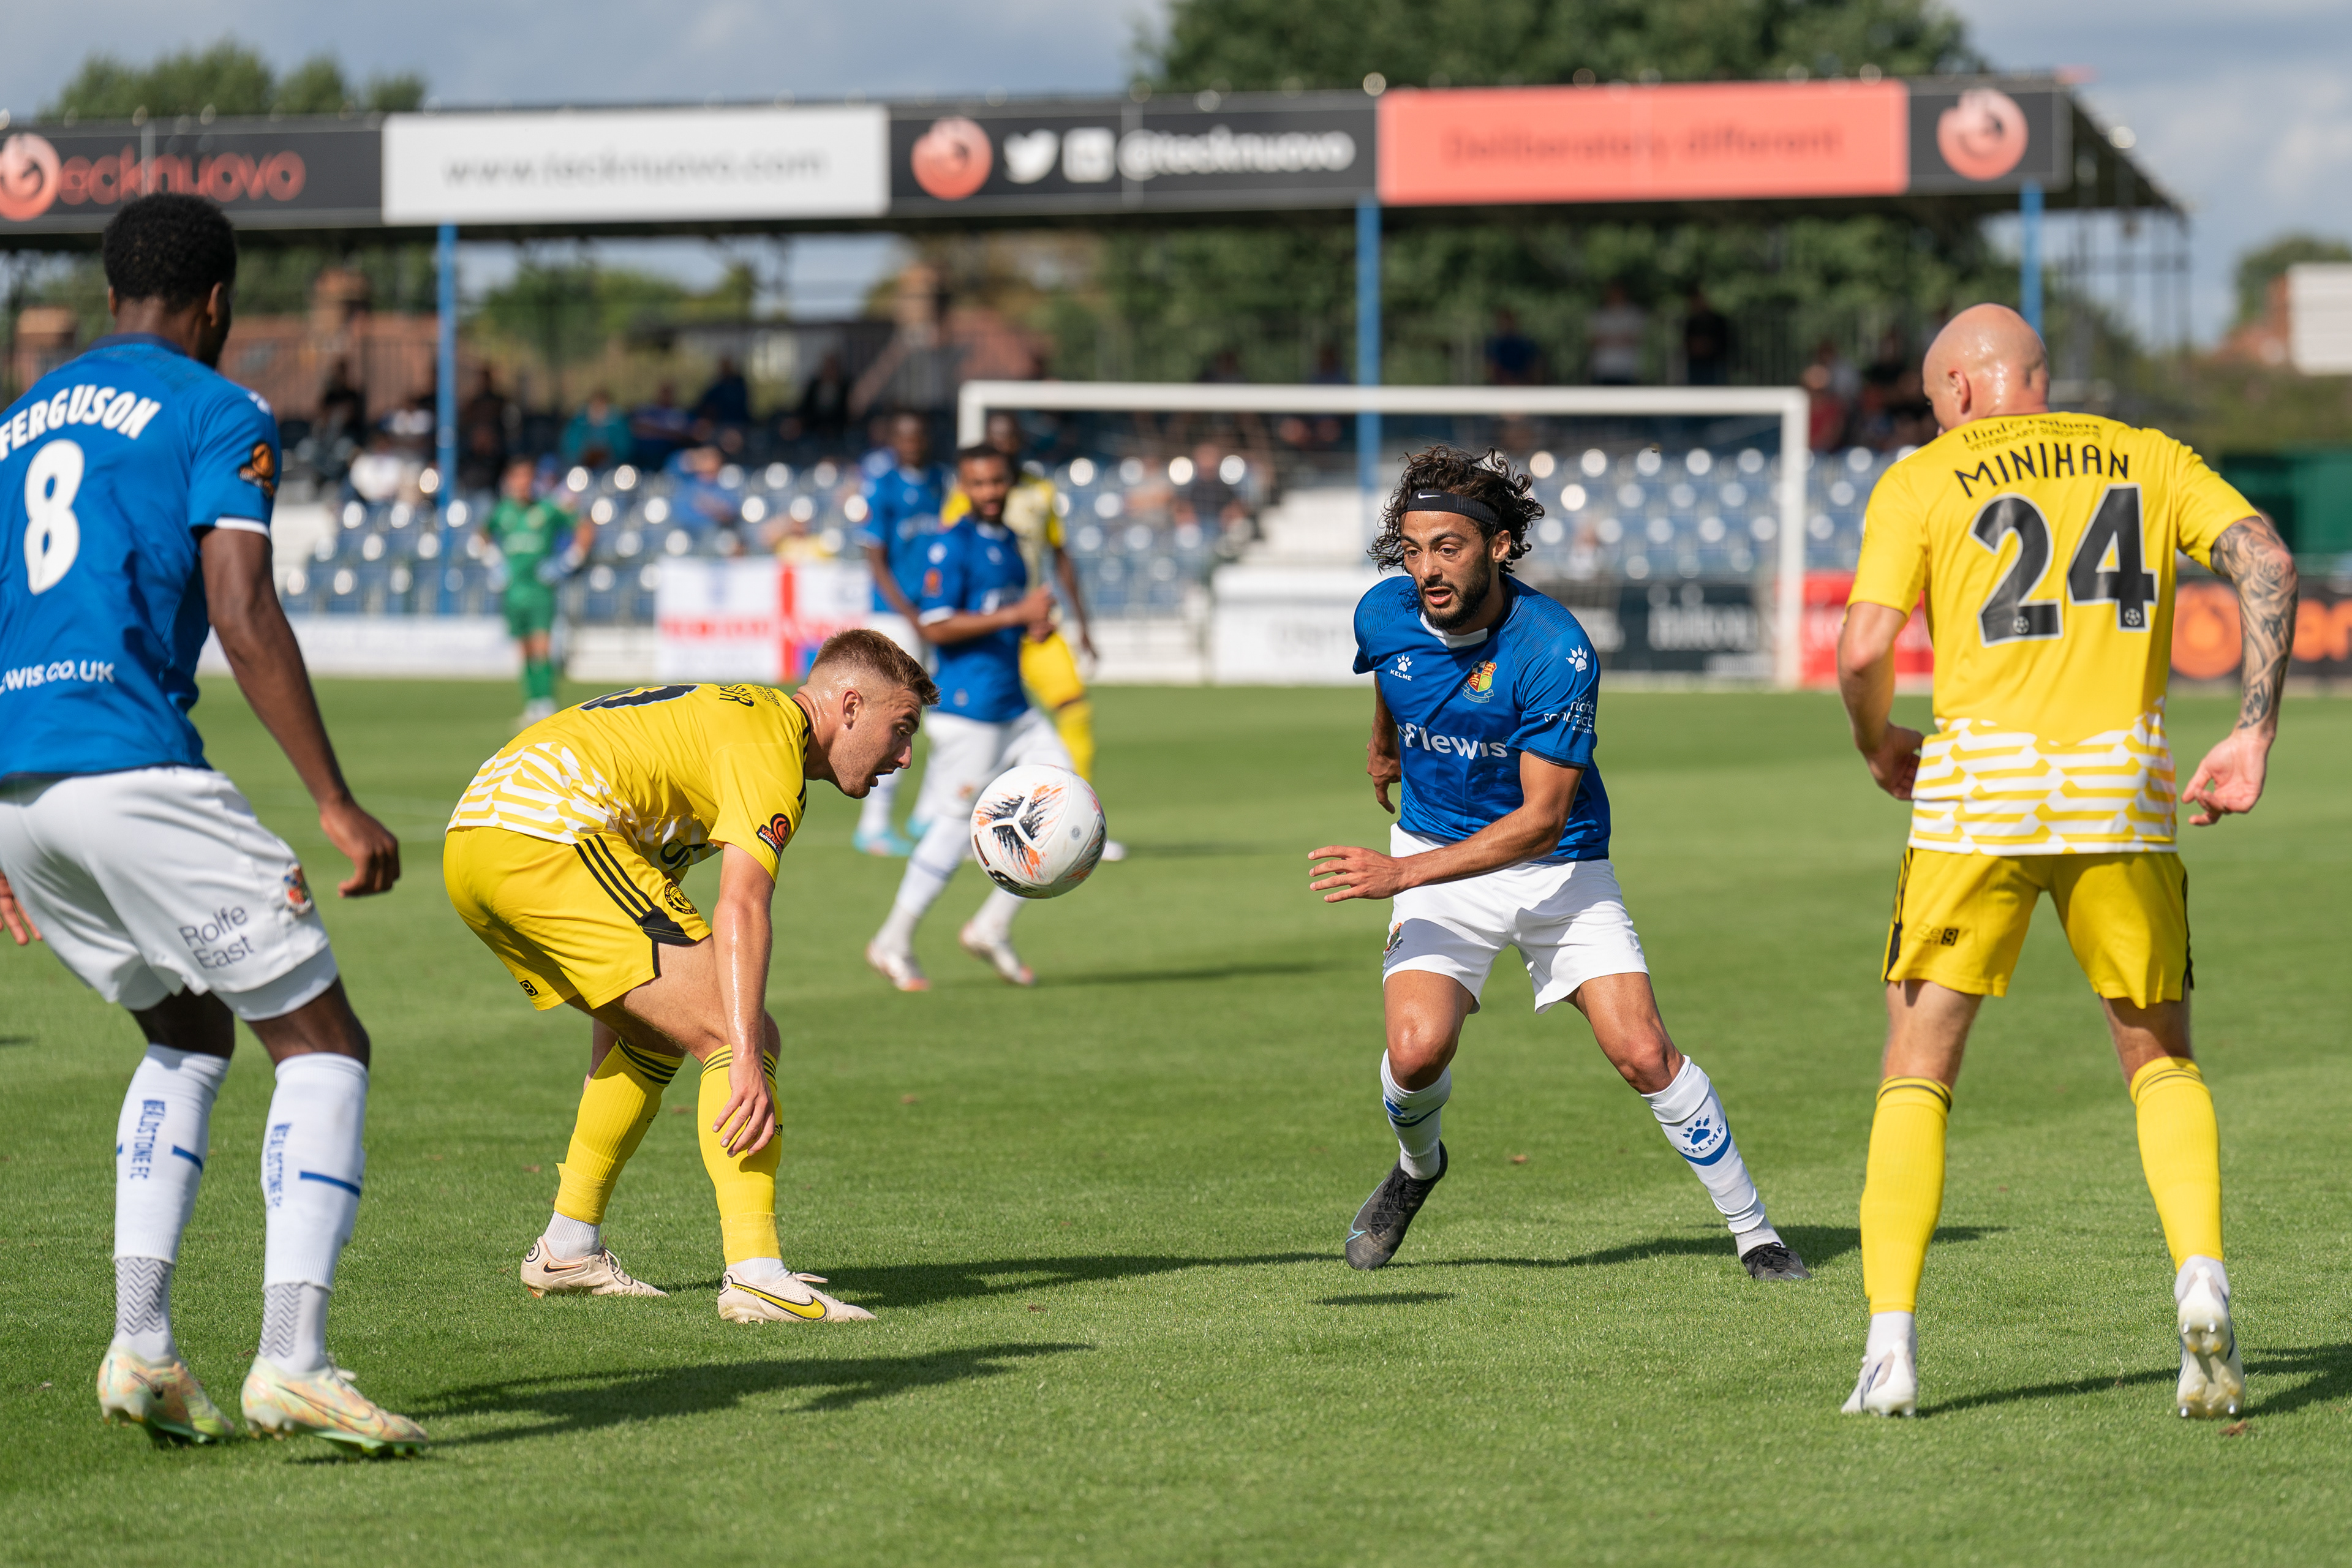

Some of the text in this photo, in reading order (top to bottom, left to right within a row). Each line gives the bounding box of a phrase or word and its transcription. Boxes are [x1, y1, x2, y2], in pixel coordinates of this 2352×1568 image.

[0, 384, 162, 462] FERGUSON
[1954, 442, 2128, 498] MINIHAN
[23, 438, 85, 596] 8
[1968, 483, 2160, 649] 24
[1390, 669, 1412, 682] KELME
[758, 832, 777, 850] NATIONAL
[178, 907, 248, 948] Rolfe
[193, 933, 254, 969] East
[1682, 1124, 1723, 1153] KELME
[129, 1166, 150, 1180] FC
